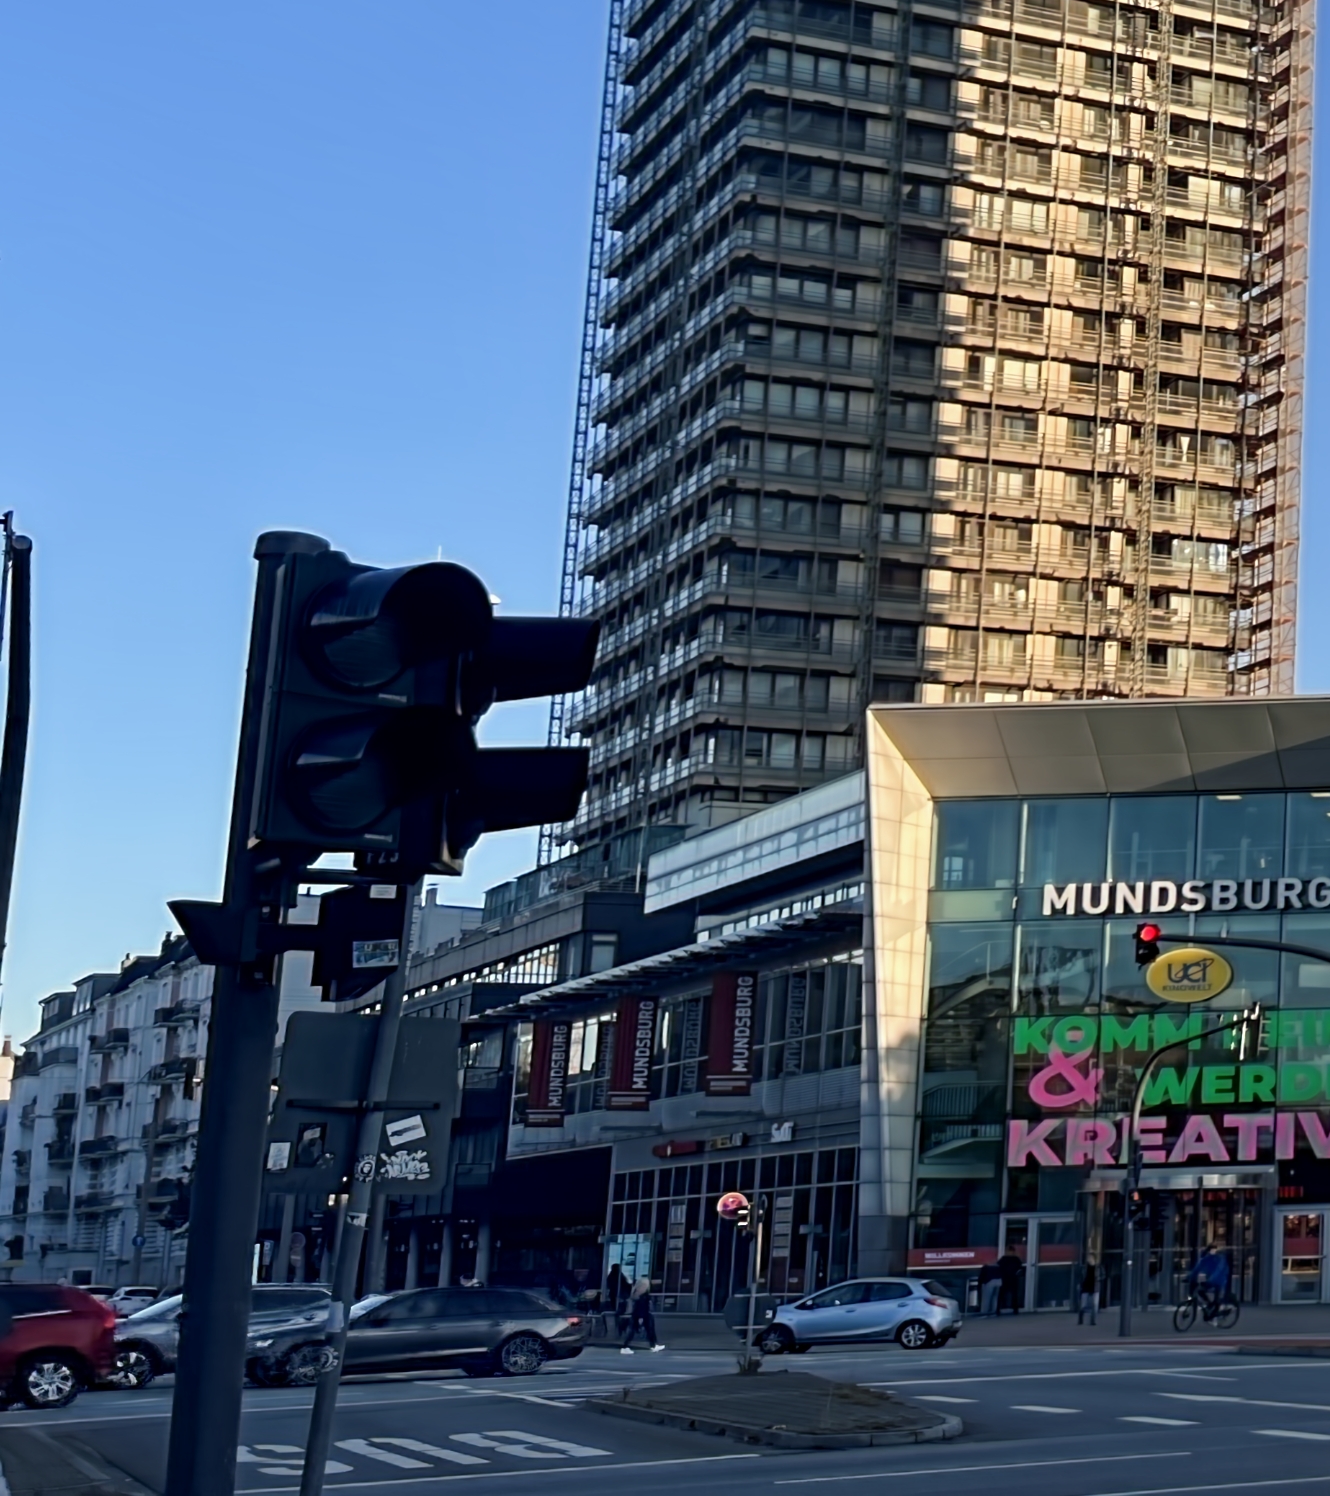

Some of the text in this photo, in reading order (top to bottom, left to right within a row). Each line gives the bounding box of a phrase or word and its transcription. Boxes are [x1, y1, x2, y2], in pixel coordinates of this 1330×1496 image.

[1167, 960, 1212, 983] UCI
[632, 1001, 654, 1089] MUNDSBURG
[732, 976, 754, 1072] MUNDSBURG
[1013, 1012, 1199, 1054] KOMM
[548, 1025, 567, 1106] MUNDSBURG
[1028, 1034, 1103, 1107] &
